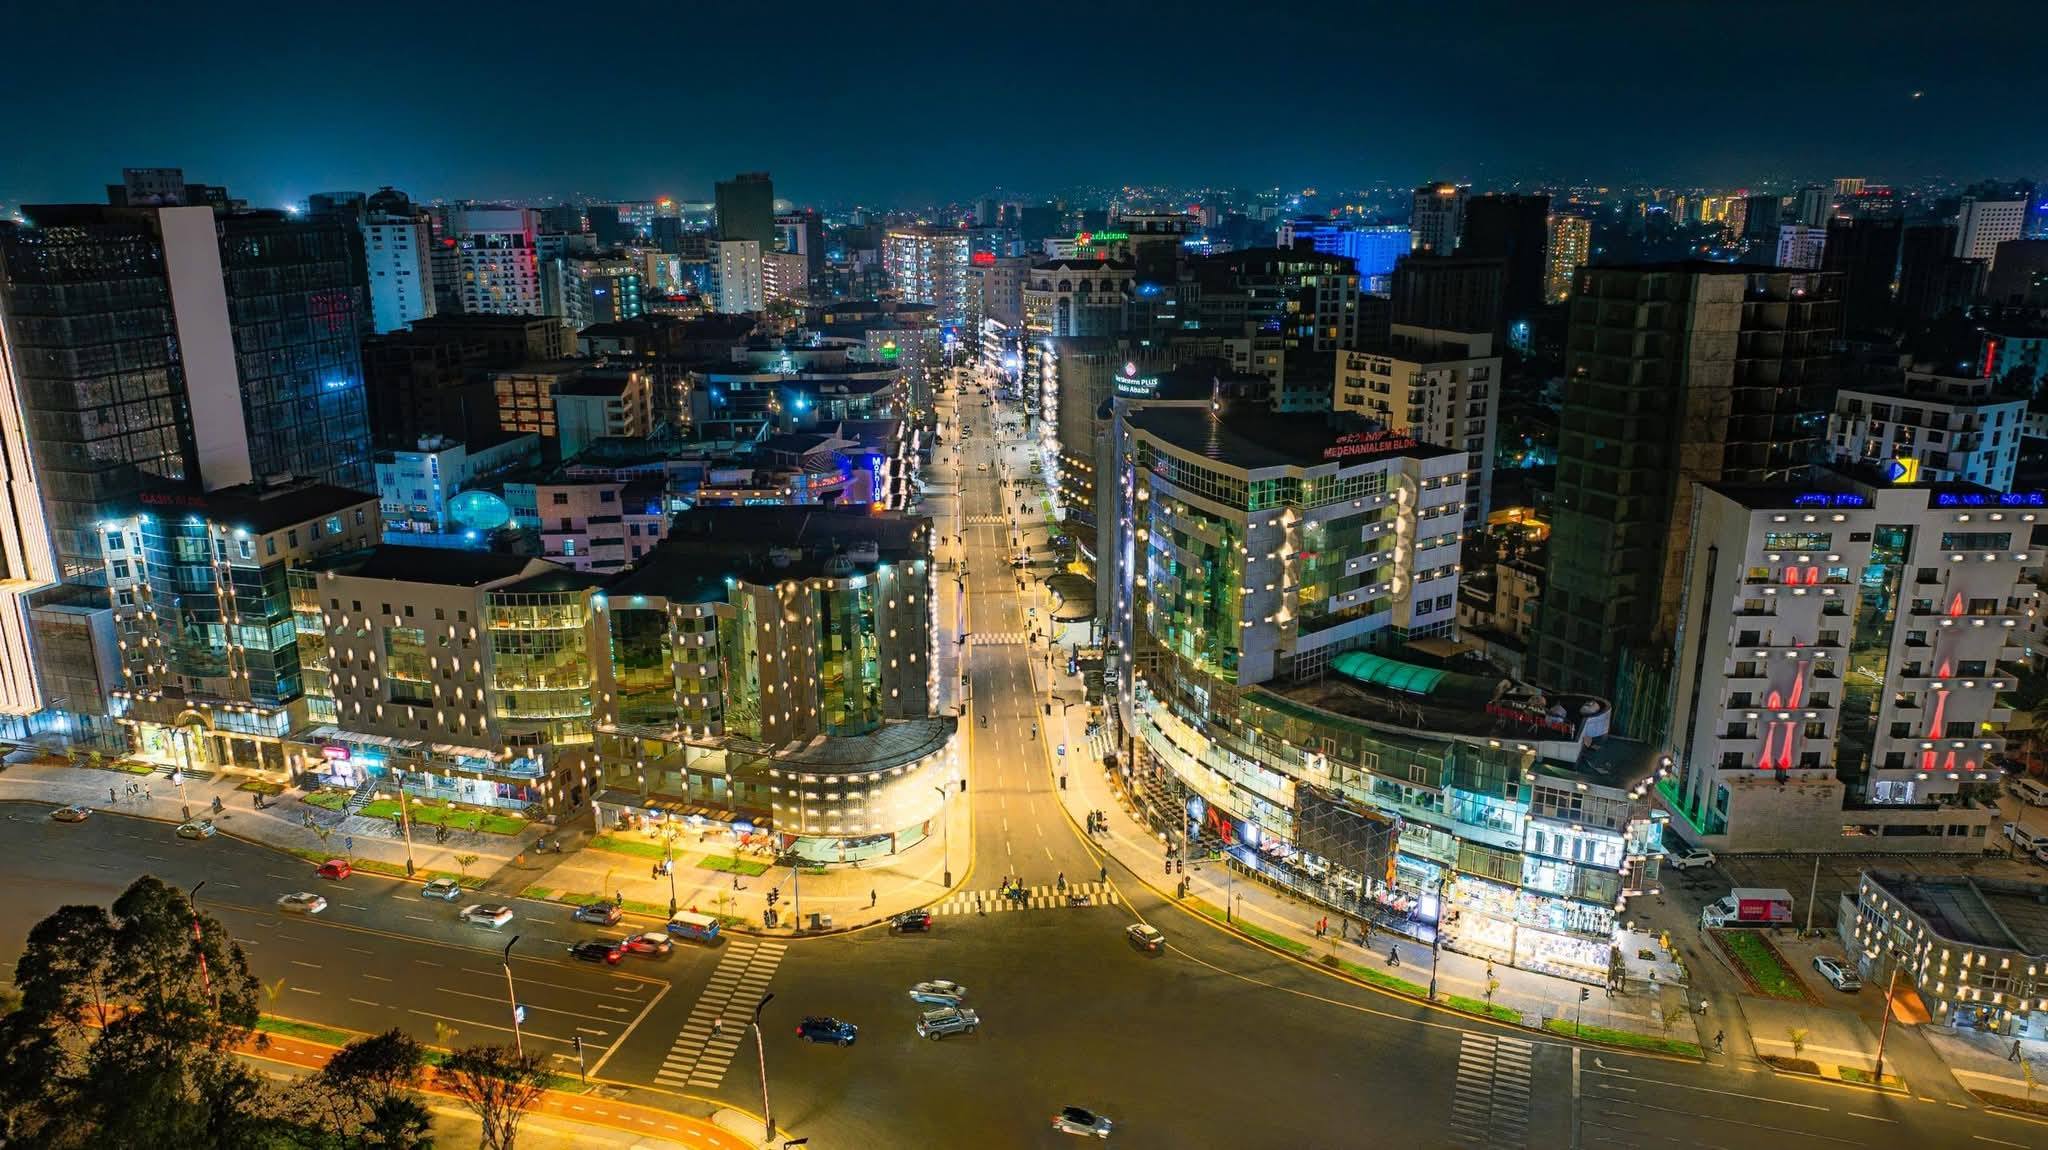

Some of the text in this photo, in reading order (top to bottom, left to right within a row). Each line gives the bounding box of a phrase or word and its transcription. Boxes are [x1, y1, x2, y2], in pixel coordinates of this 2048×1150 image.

[1141, 378, 1158, 386] PLUS
[1129, 385, 1149, 394] Ababa
[872, 457, 881, 501] Morning
